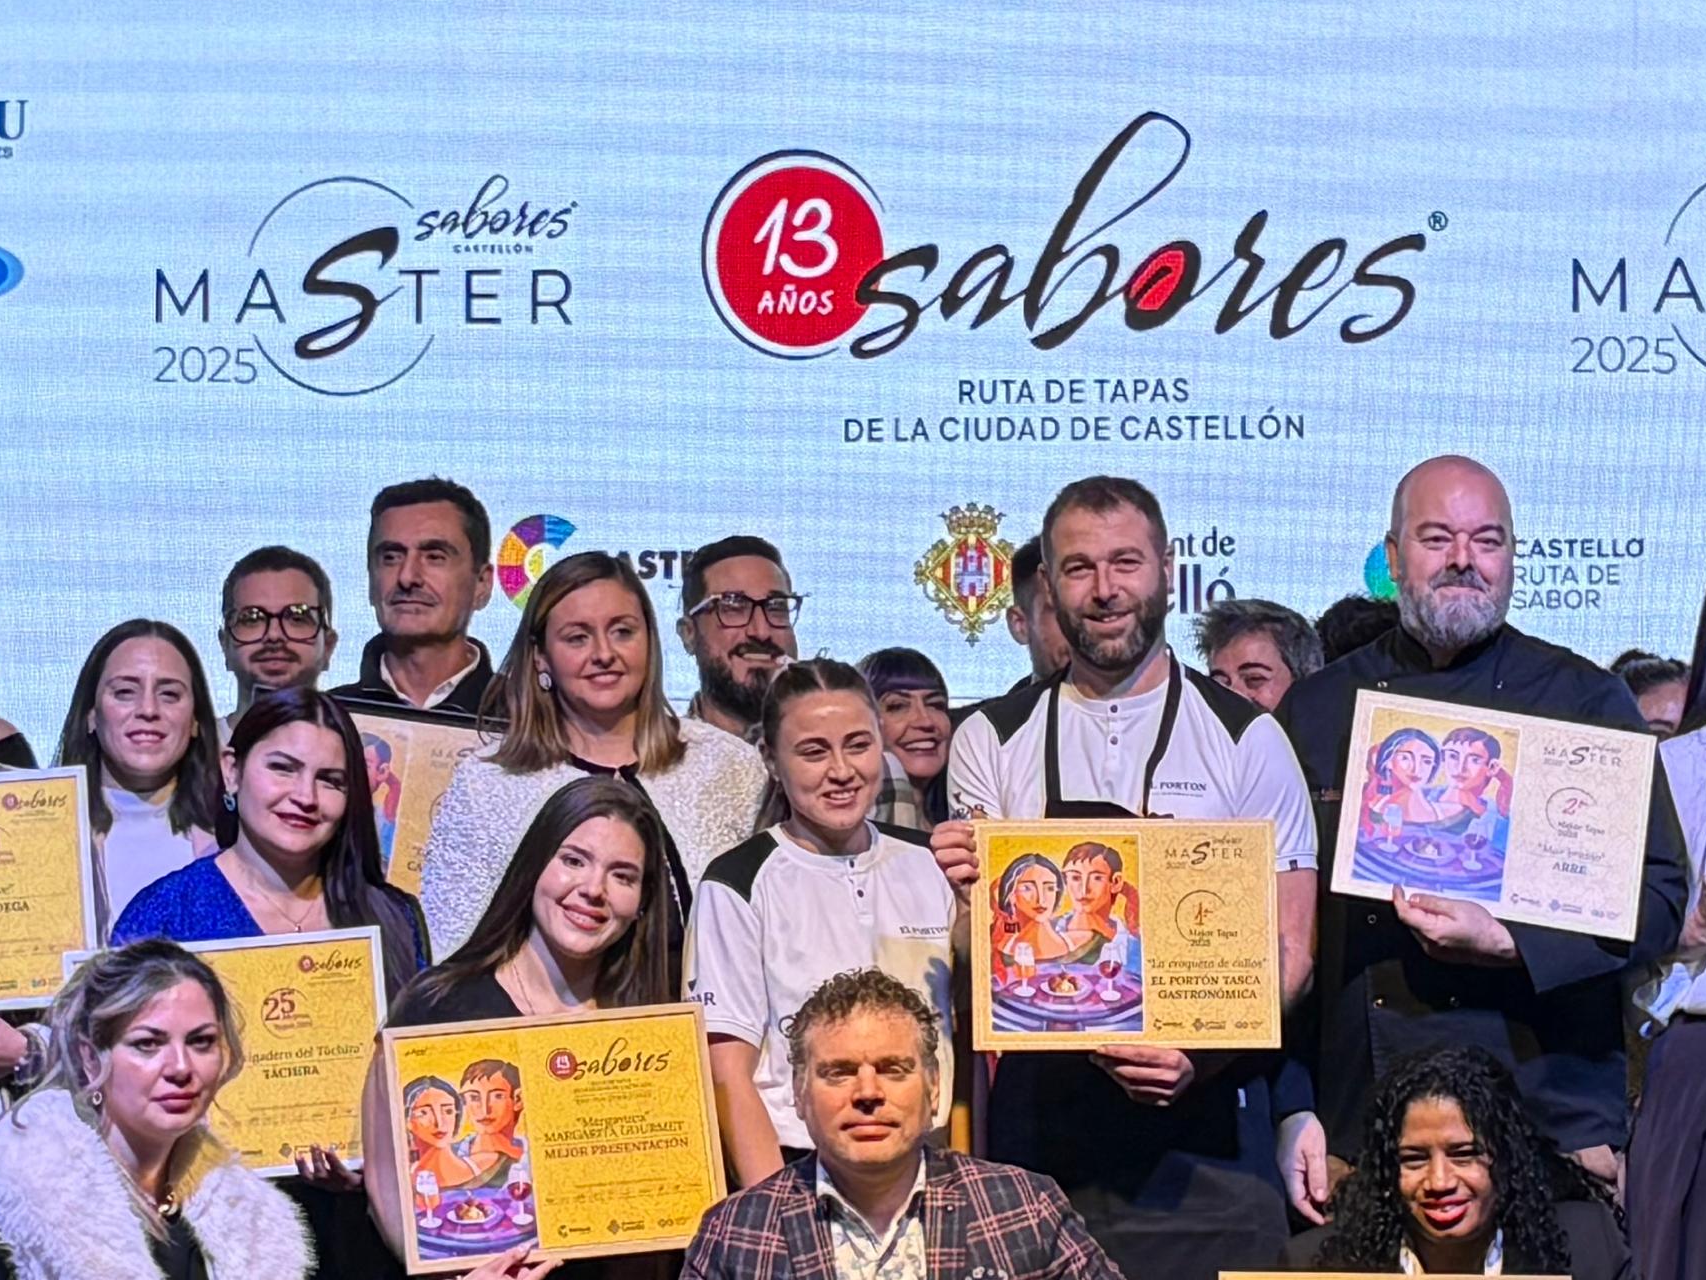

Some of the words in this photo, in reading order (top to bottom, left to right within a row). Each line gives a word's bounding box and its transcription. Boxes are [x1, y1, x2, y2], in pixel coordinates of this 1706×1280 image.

[754, 197, 840, 277] 13
[154, 226, 573, 360] MASTER
[757, 287, 835, 317] AÑOS
[153, 345, 257, 384] 2025
[1571, 336, 1677, 374] 2025
[958, 379, 1035, 404] RUTA
[1045, 379, 1085, 403] DE
[1097, 378, 1189, 403] TAPAS
[844, 419, 884, 443] DE
[894, 418, 930, 442] LA
[939, 417, 1060, 442] CIUDAD
[1070, 416, 1112, 441] DE
[1120, 406, 1305, 441] CASTELLÓN
[1201, 526, 1236, 557] de
[1514, 565, 1580, 586] RUTA
[1588, 565, 1620, 585] DE
[1512, 589, 1601, 609] SABOR
[1164, 840, 1243, 865] MASTER
[1151, 976, 1166, 986] EL
[1169, 973, 1219, 986] PORTÓN
[1223, 976, 1261, 986] TASCA
[1158, 986, 1257, 1000] GASTRONÓMICA
[264, 991, 296, 1021] 25
[545, 1147, 588, 1160] MEJOR
[591, 1137, 689, 1155] PRESENTACIÓN
